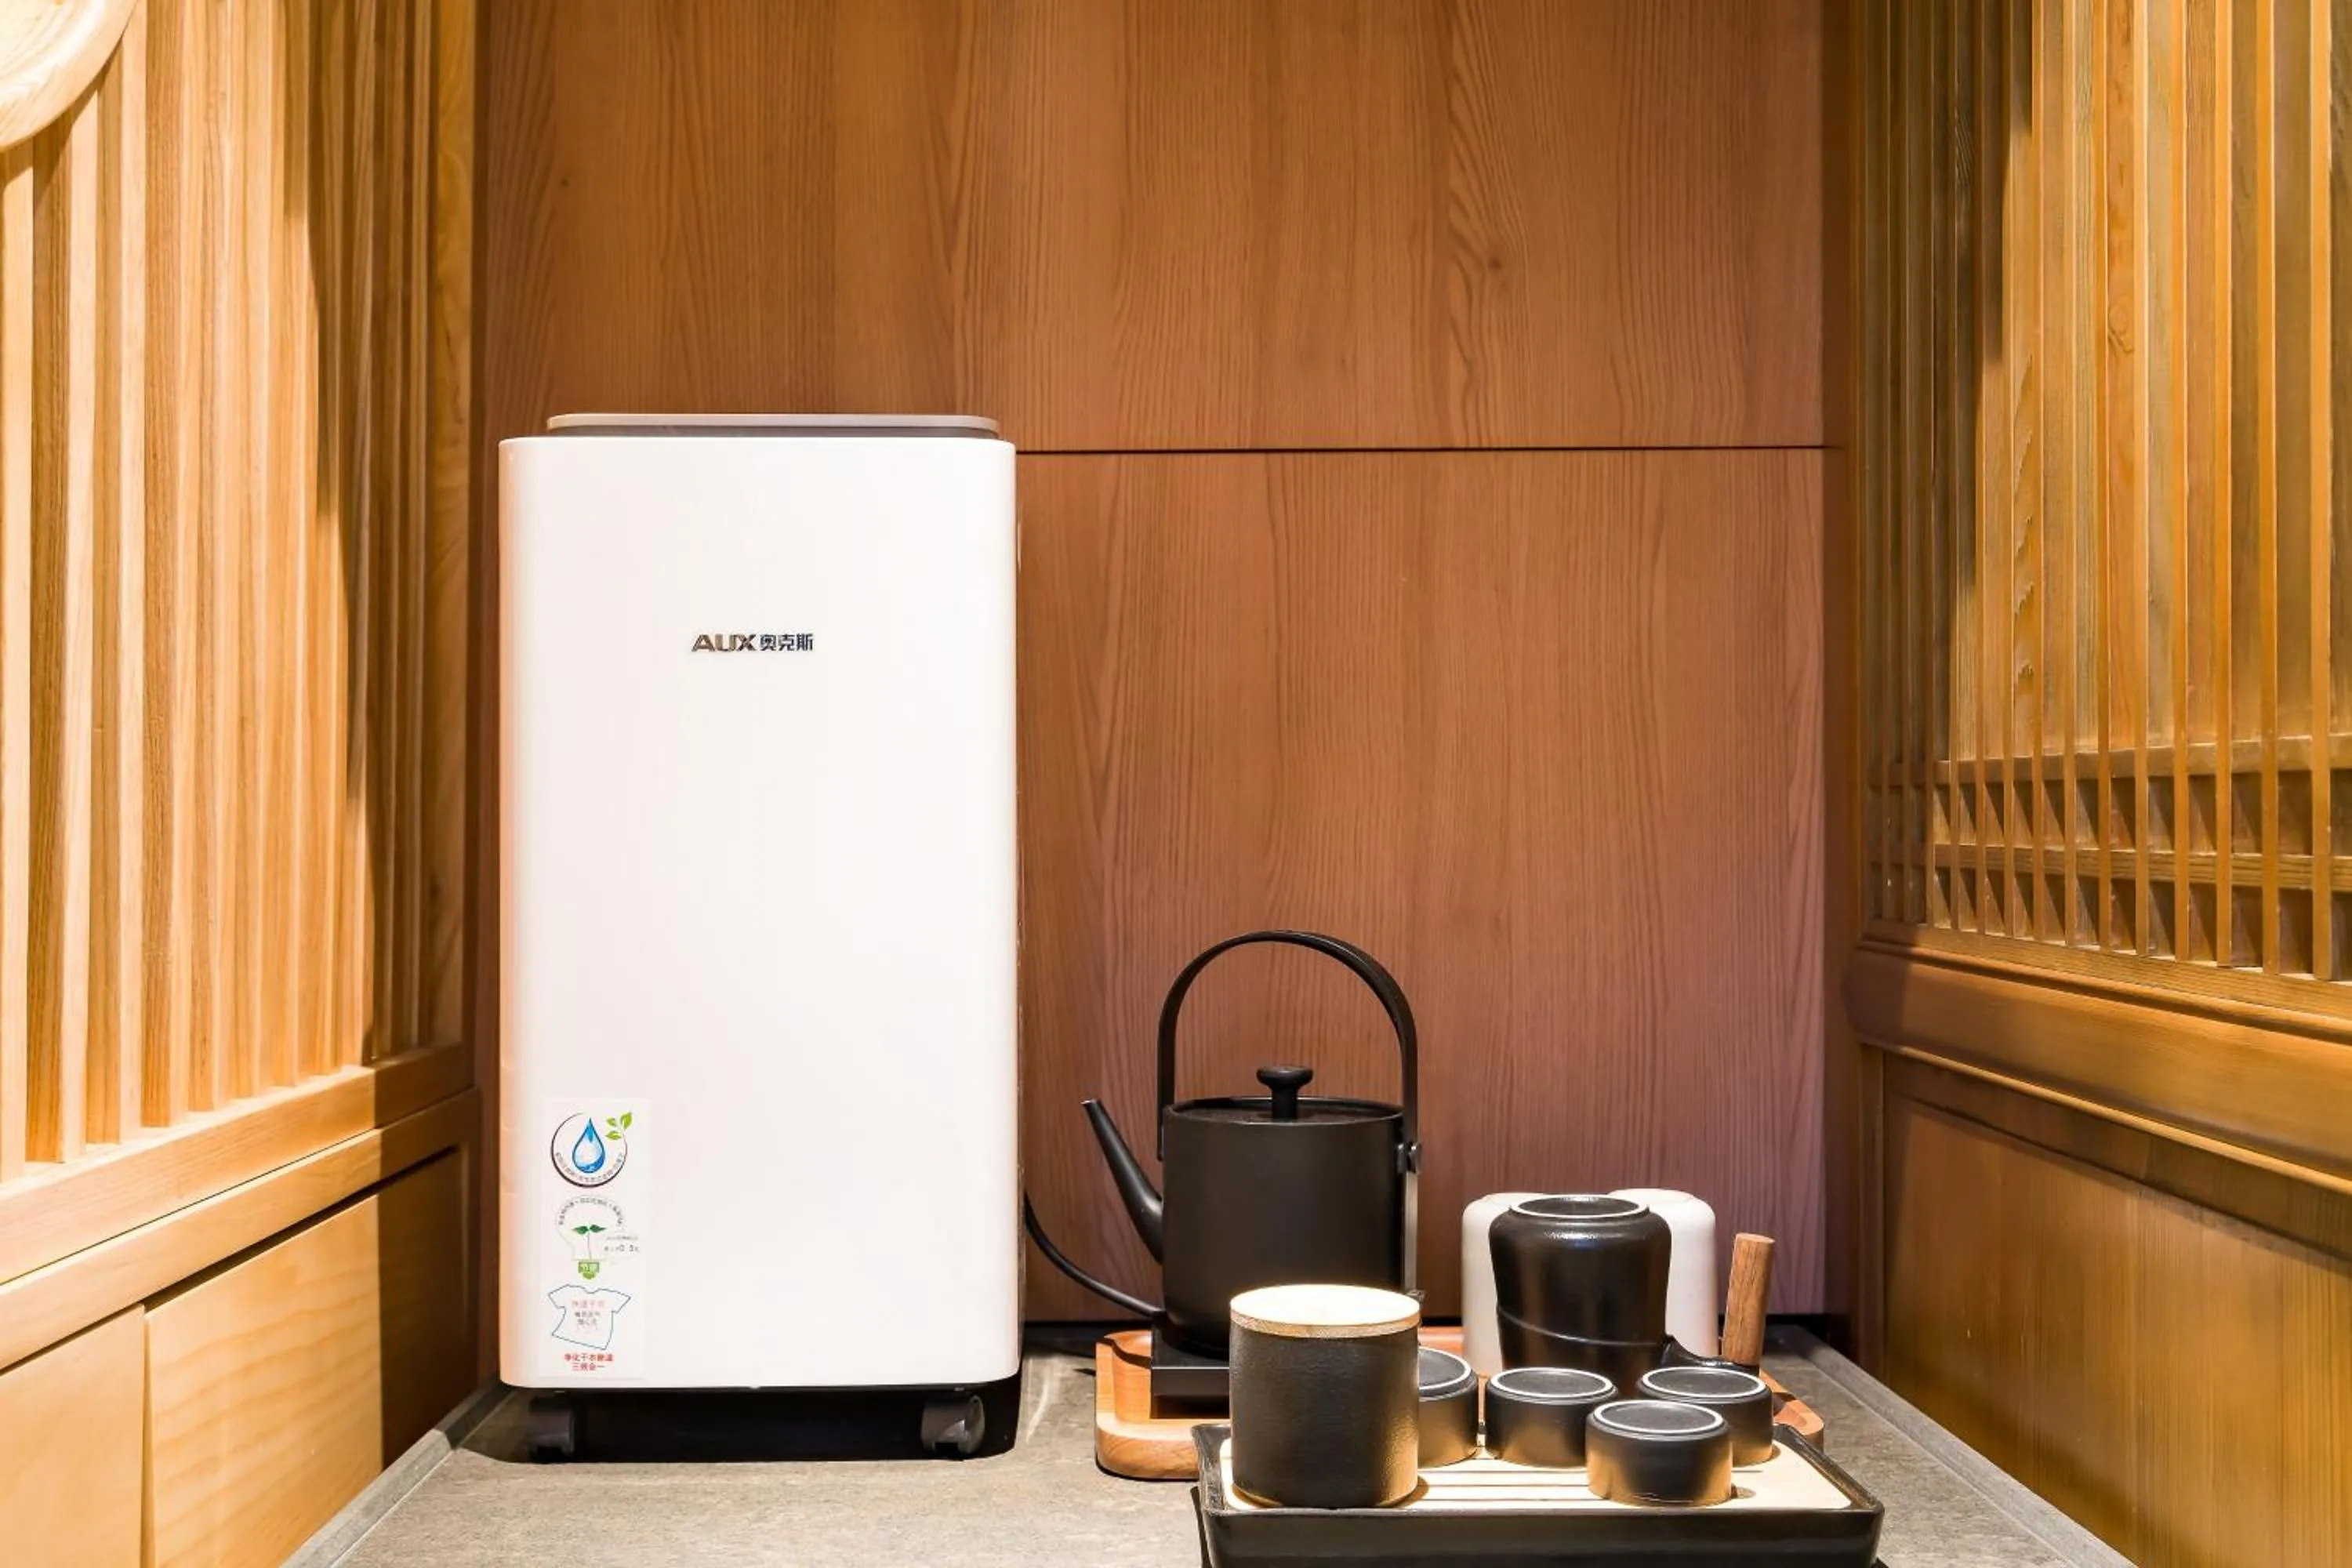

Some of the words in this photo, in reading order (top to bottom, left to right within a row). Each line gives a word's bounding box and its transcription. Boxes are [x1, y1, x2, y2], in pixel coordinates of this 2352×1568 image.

[691, 633, 757, 652] AUX
[760, 633, 815, 652] 奥克斯
